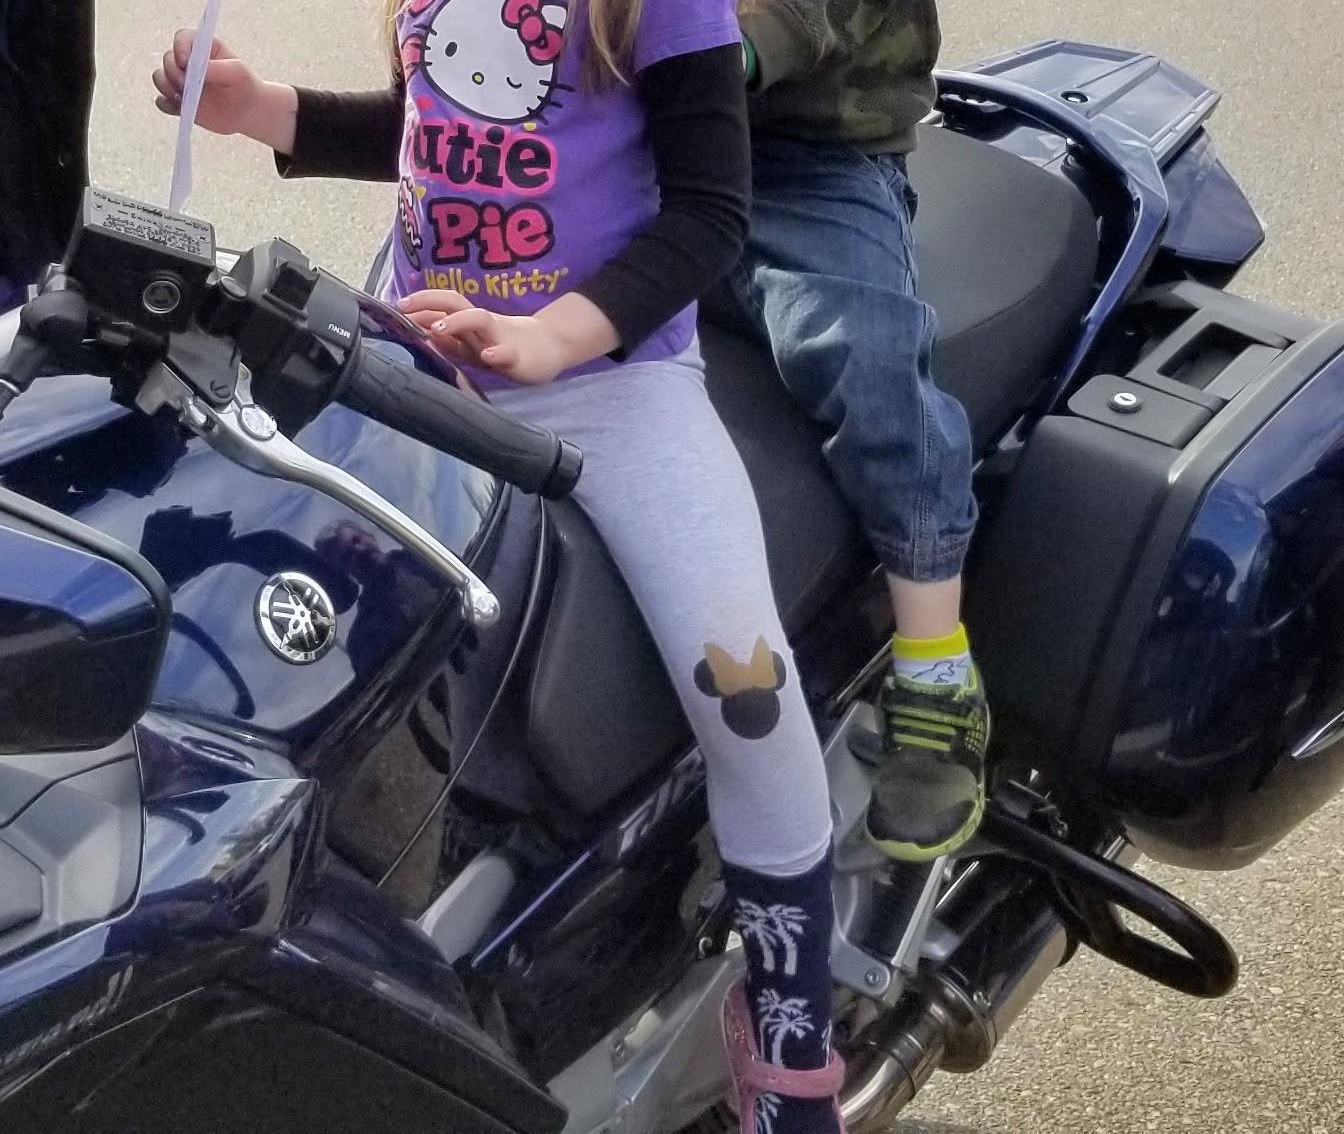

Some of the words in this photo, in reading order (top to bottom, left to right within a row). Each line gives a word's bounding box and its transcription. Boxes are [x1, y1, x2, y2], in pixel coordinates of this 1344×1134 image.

[413, 123, 552, 189] utie
[428, 198, 553, 270] Pie
[424, 267, 480, 295] Hello
[327, 323, 351, 339] MENU
